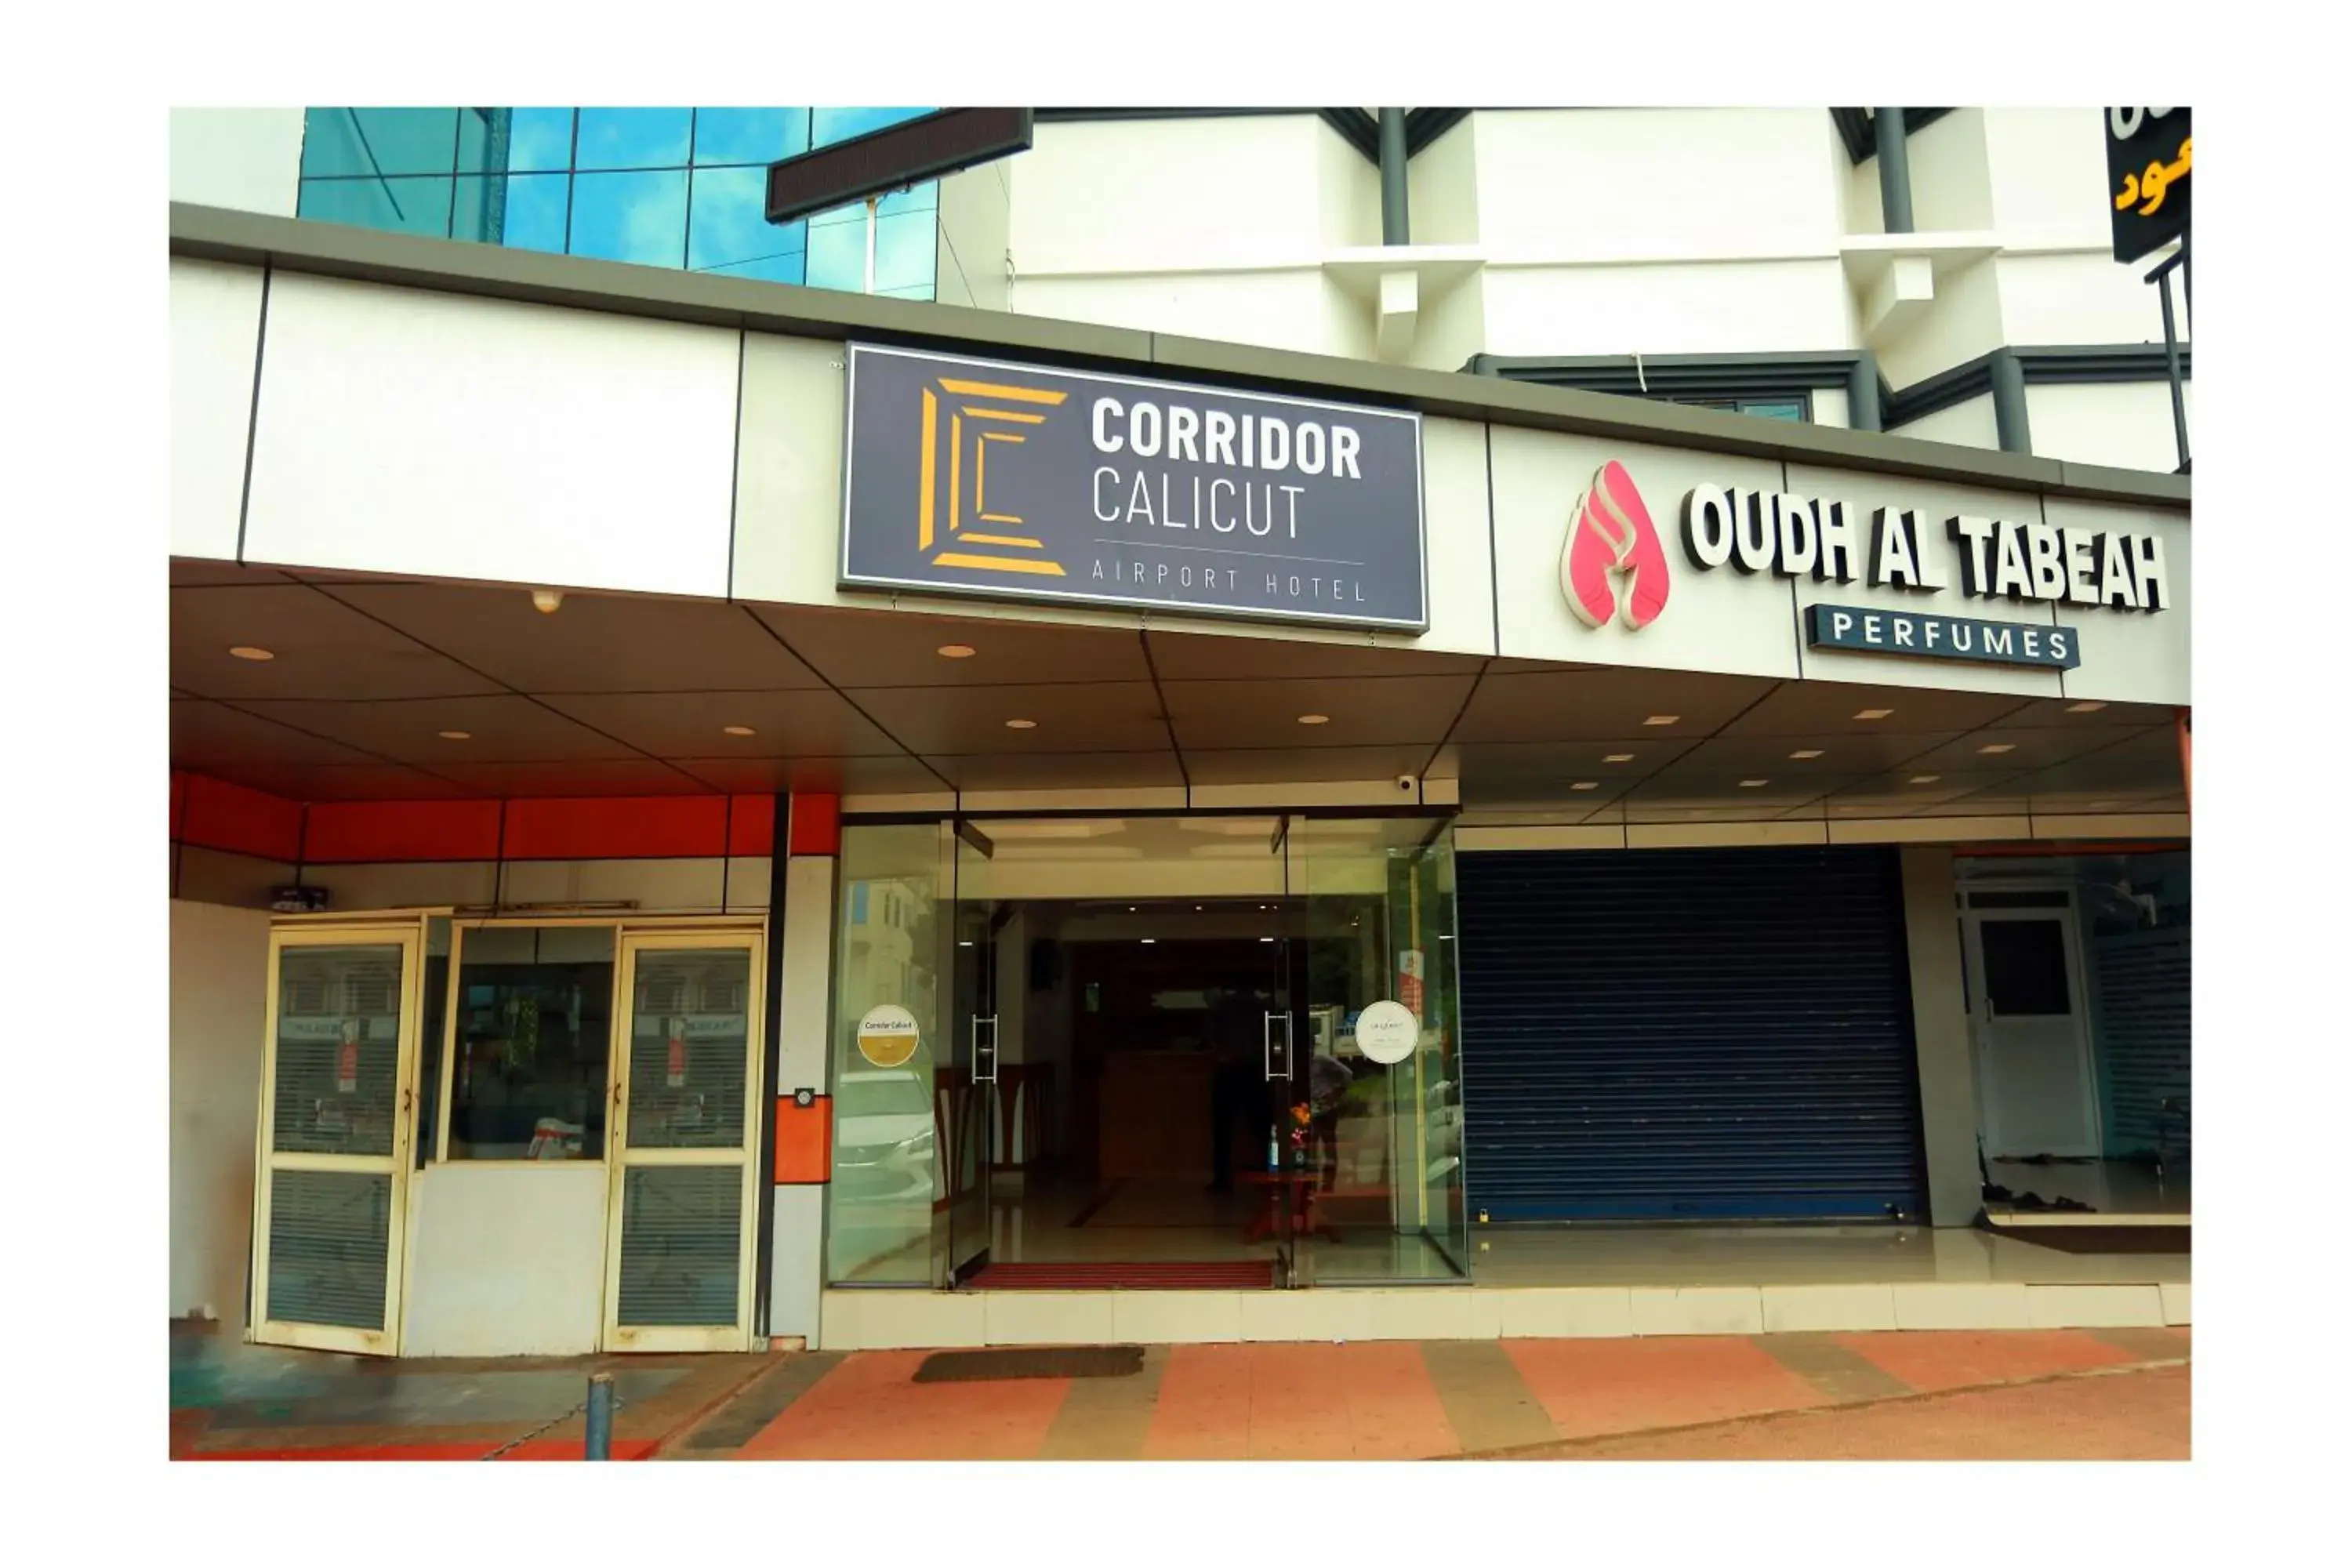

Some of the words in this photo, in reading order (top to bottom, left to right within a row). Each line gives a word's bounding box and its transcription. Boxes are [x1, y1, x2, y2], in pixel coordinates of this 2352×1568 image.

[1092, 397, 1363, 480] CORRIDOR
[1093, 466, 1306, 539] CALICUT
[1091, 558, 1240, 593] AIRPORT
[1265, 571, 1367, 602] HOTEL
[1682, 483, 1860, 583] OUDH
[1871, 506, 1948, 593] AL
[1949, 515, 2171, 611] TABEAH
[1832, 612, 2068, 660] PERFUMES
